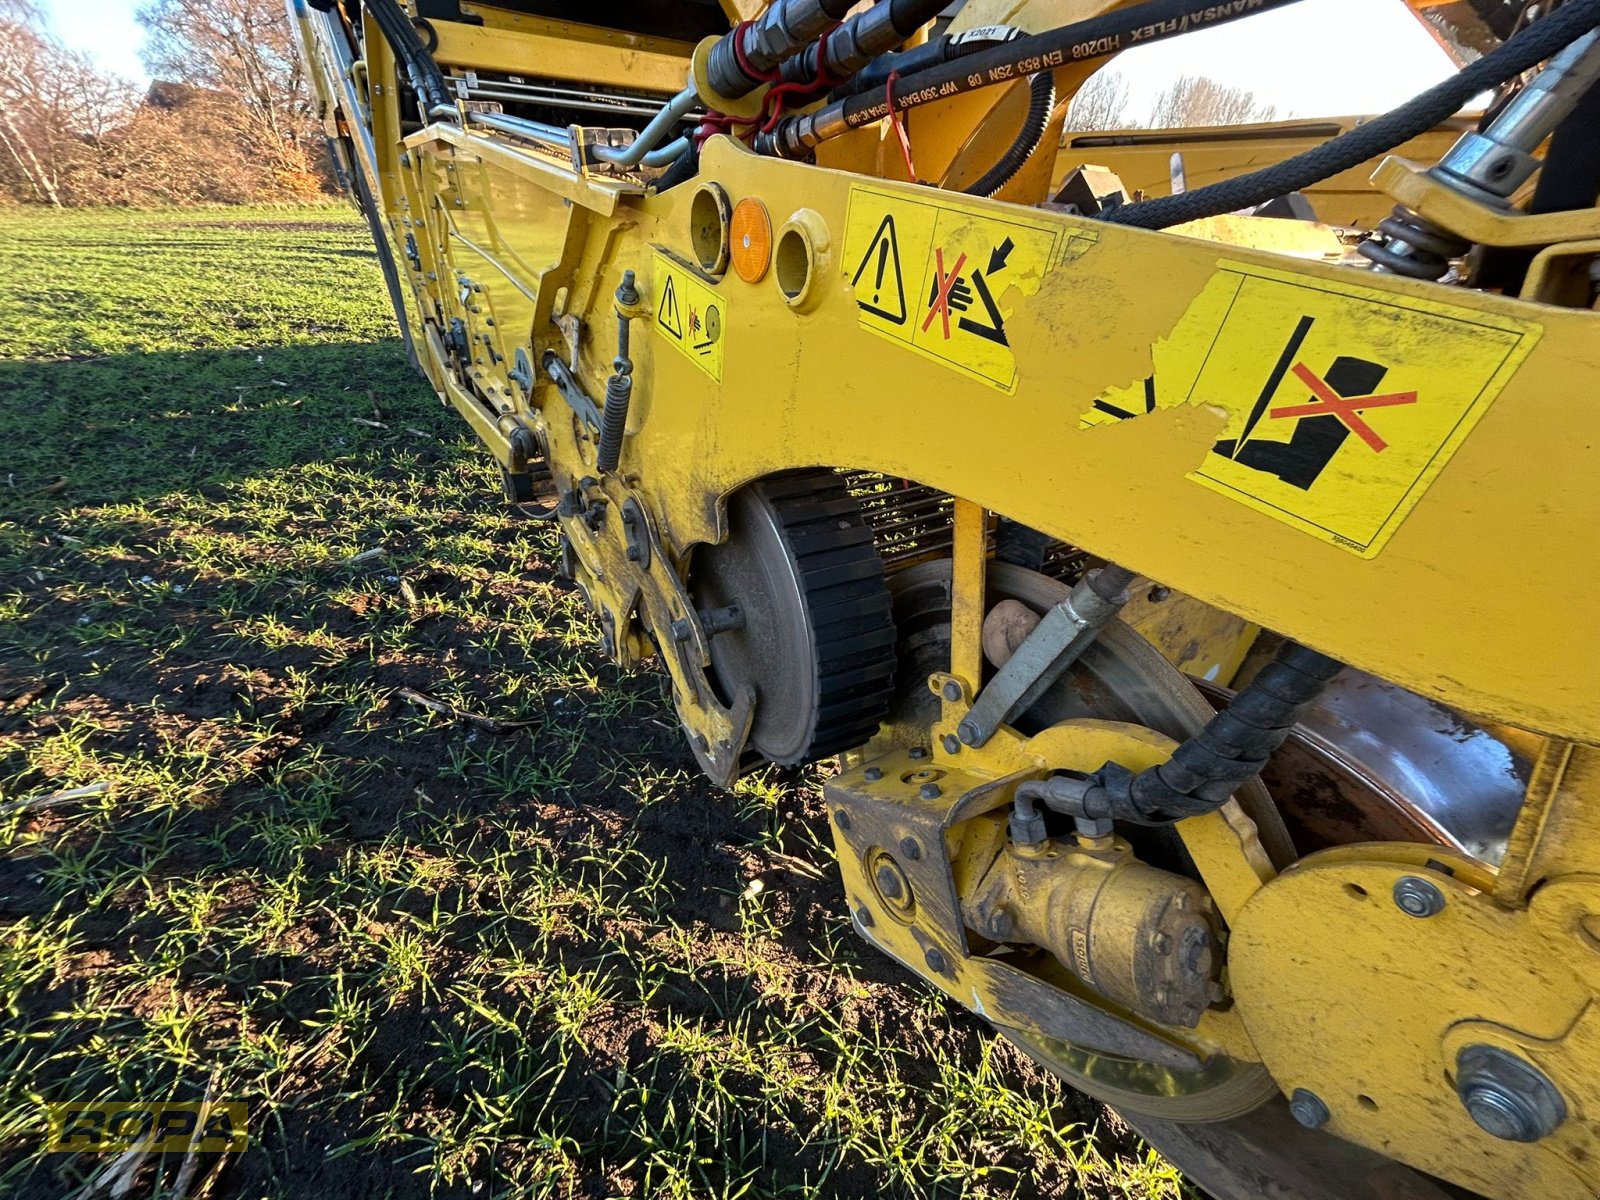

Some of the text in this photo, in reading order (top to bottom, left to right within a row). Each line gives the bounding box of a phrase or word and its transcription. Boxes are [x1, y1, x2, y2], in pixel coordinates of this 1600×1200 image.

[1072, 34, 1120, 58] HD208
[1017, 56, 1041, 73] 853
[1043, 50, 1064, 66] EN
[967, 73, 982, 87] 08
[988, 64, 1014, 81] 2SN
[919, 86, 941, 100] 350
[939, 80, 959, 96] WP
[898, 91, 922, 107] BAR
